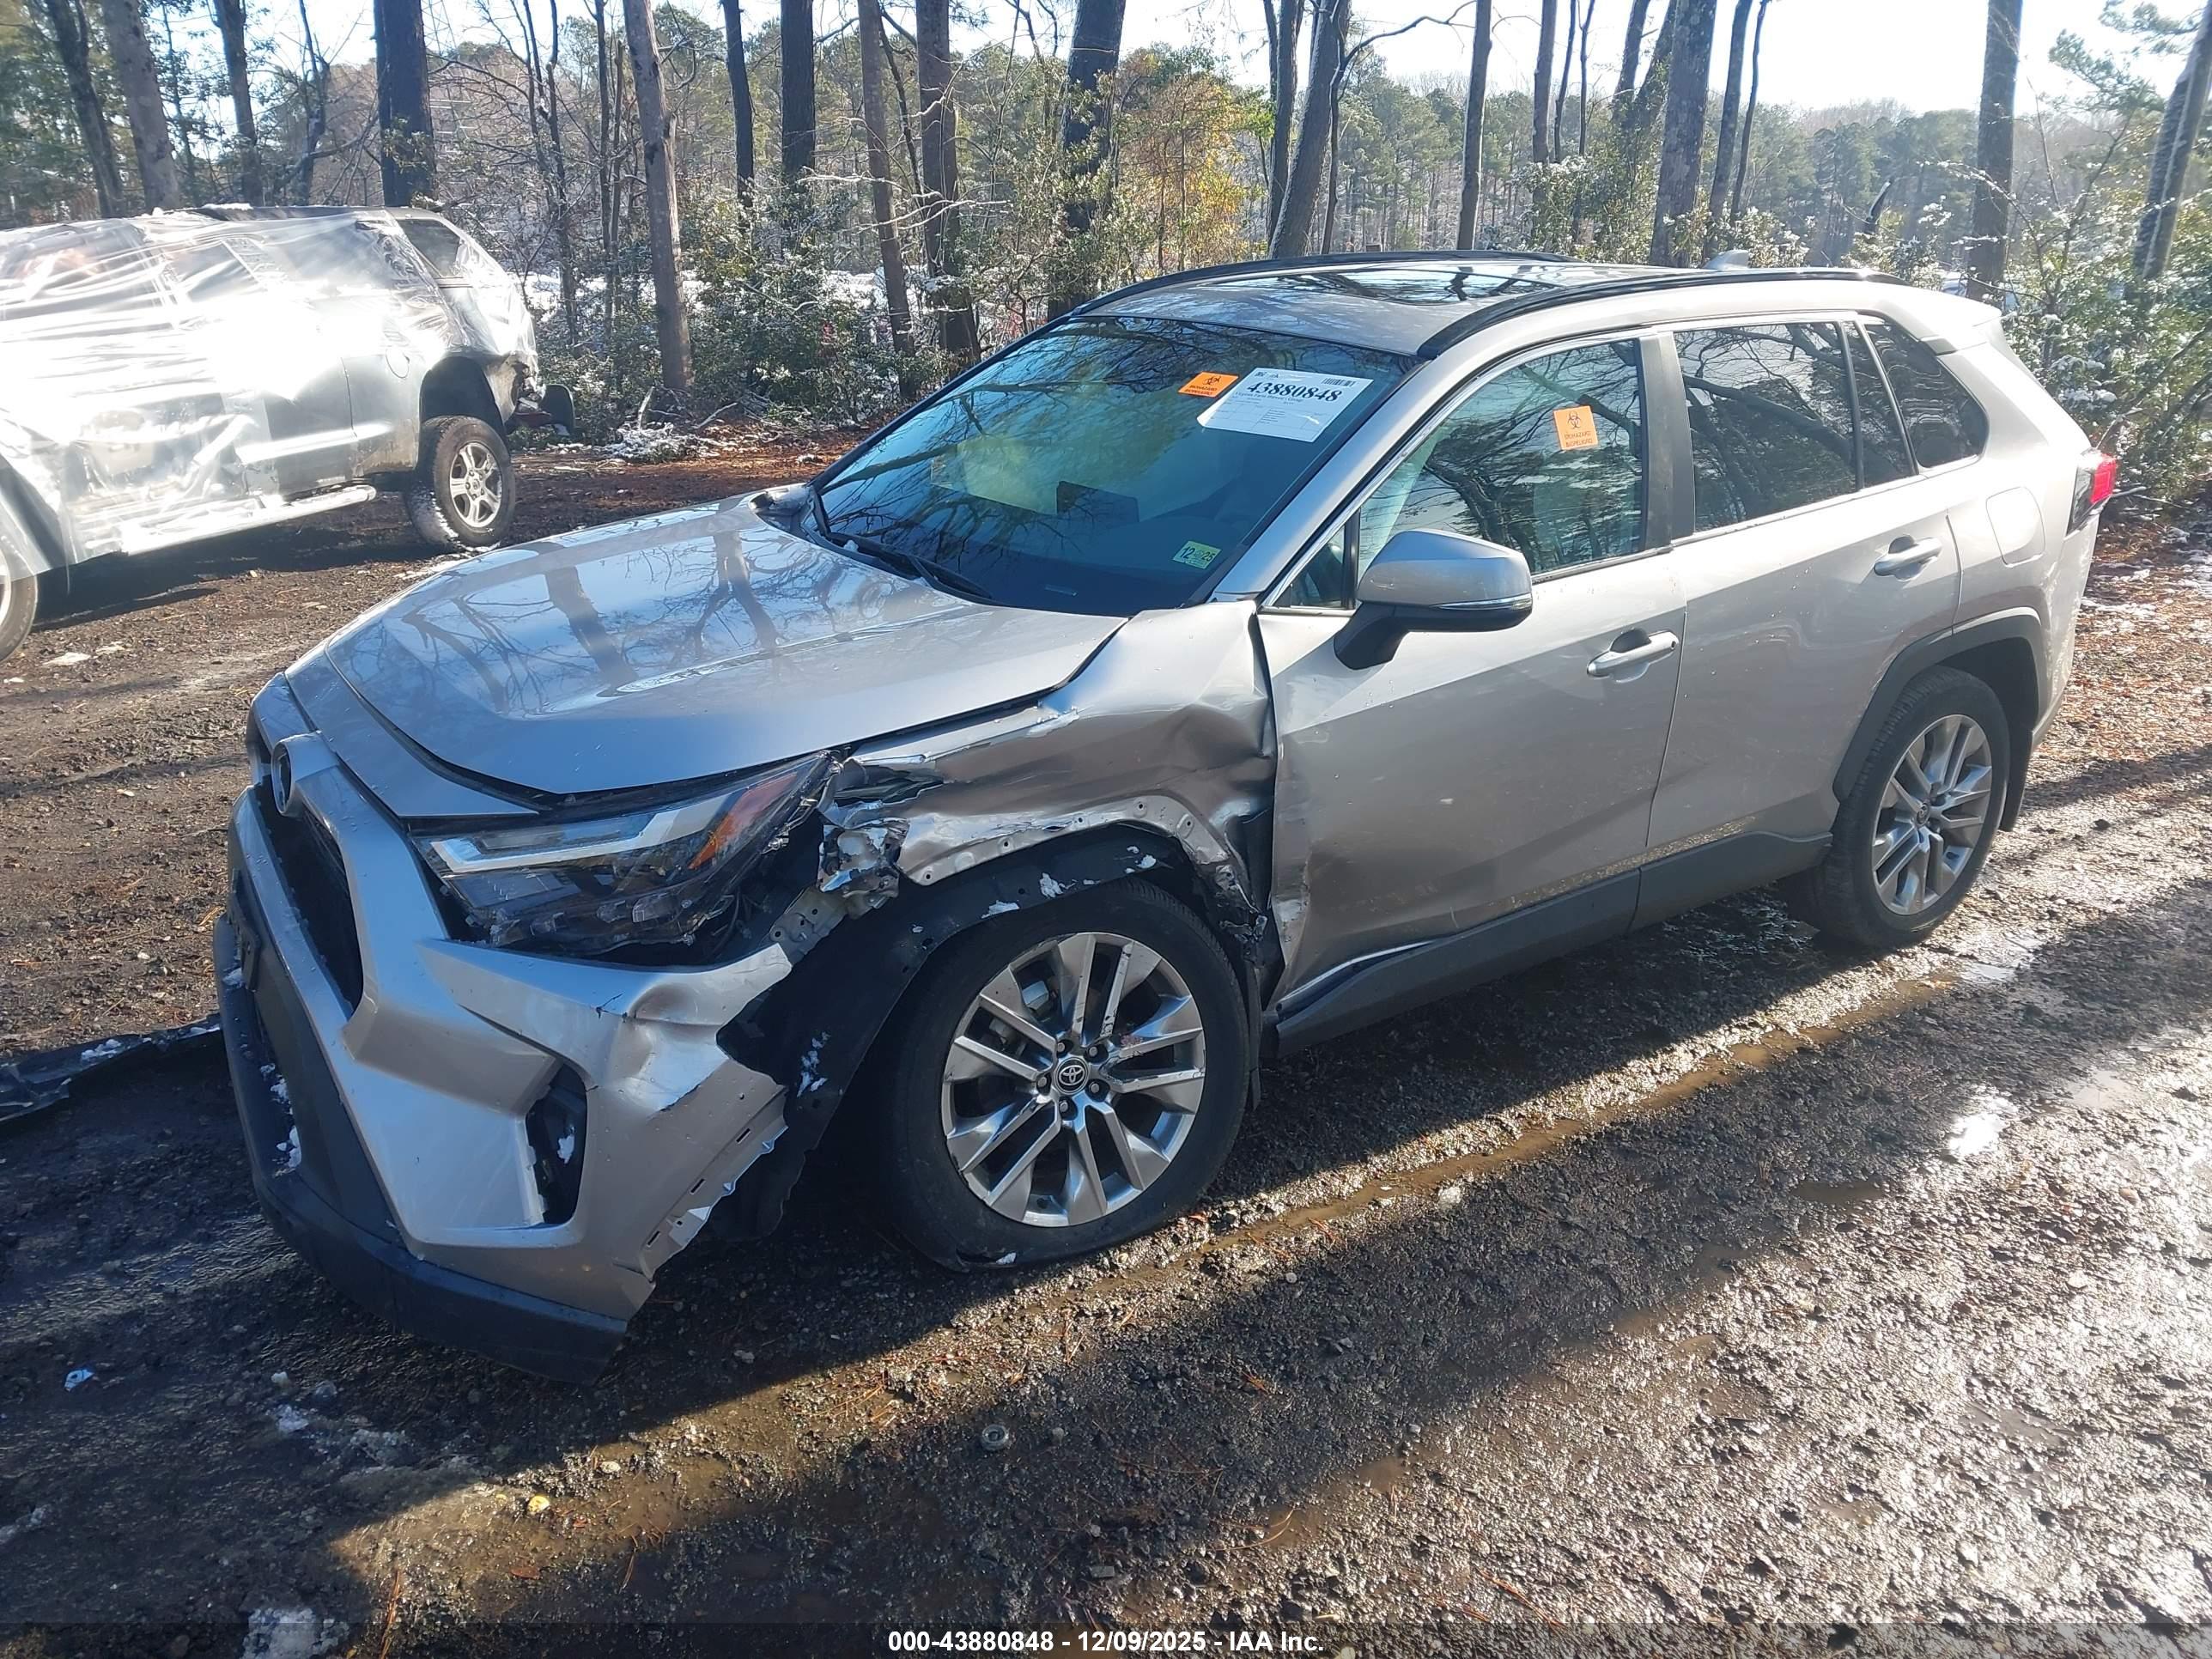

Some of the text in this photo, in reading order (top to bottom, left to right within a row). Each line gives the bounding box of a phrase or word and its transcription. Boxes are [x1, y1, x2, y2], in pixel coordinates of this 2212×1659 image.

[1247, 381, 1342, 402] 43880848
[1180, 547, 1216, 562] 12 25
